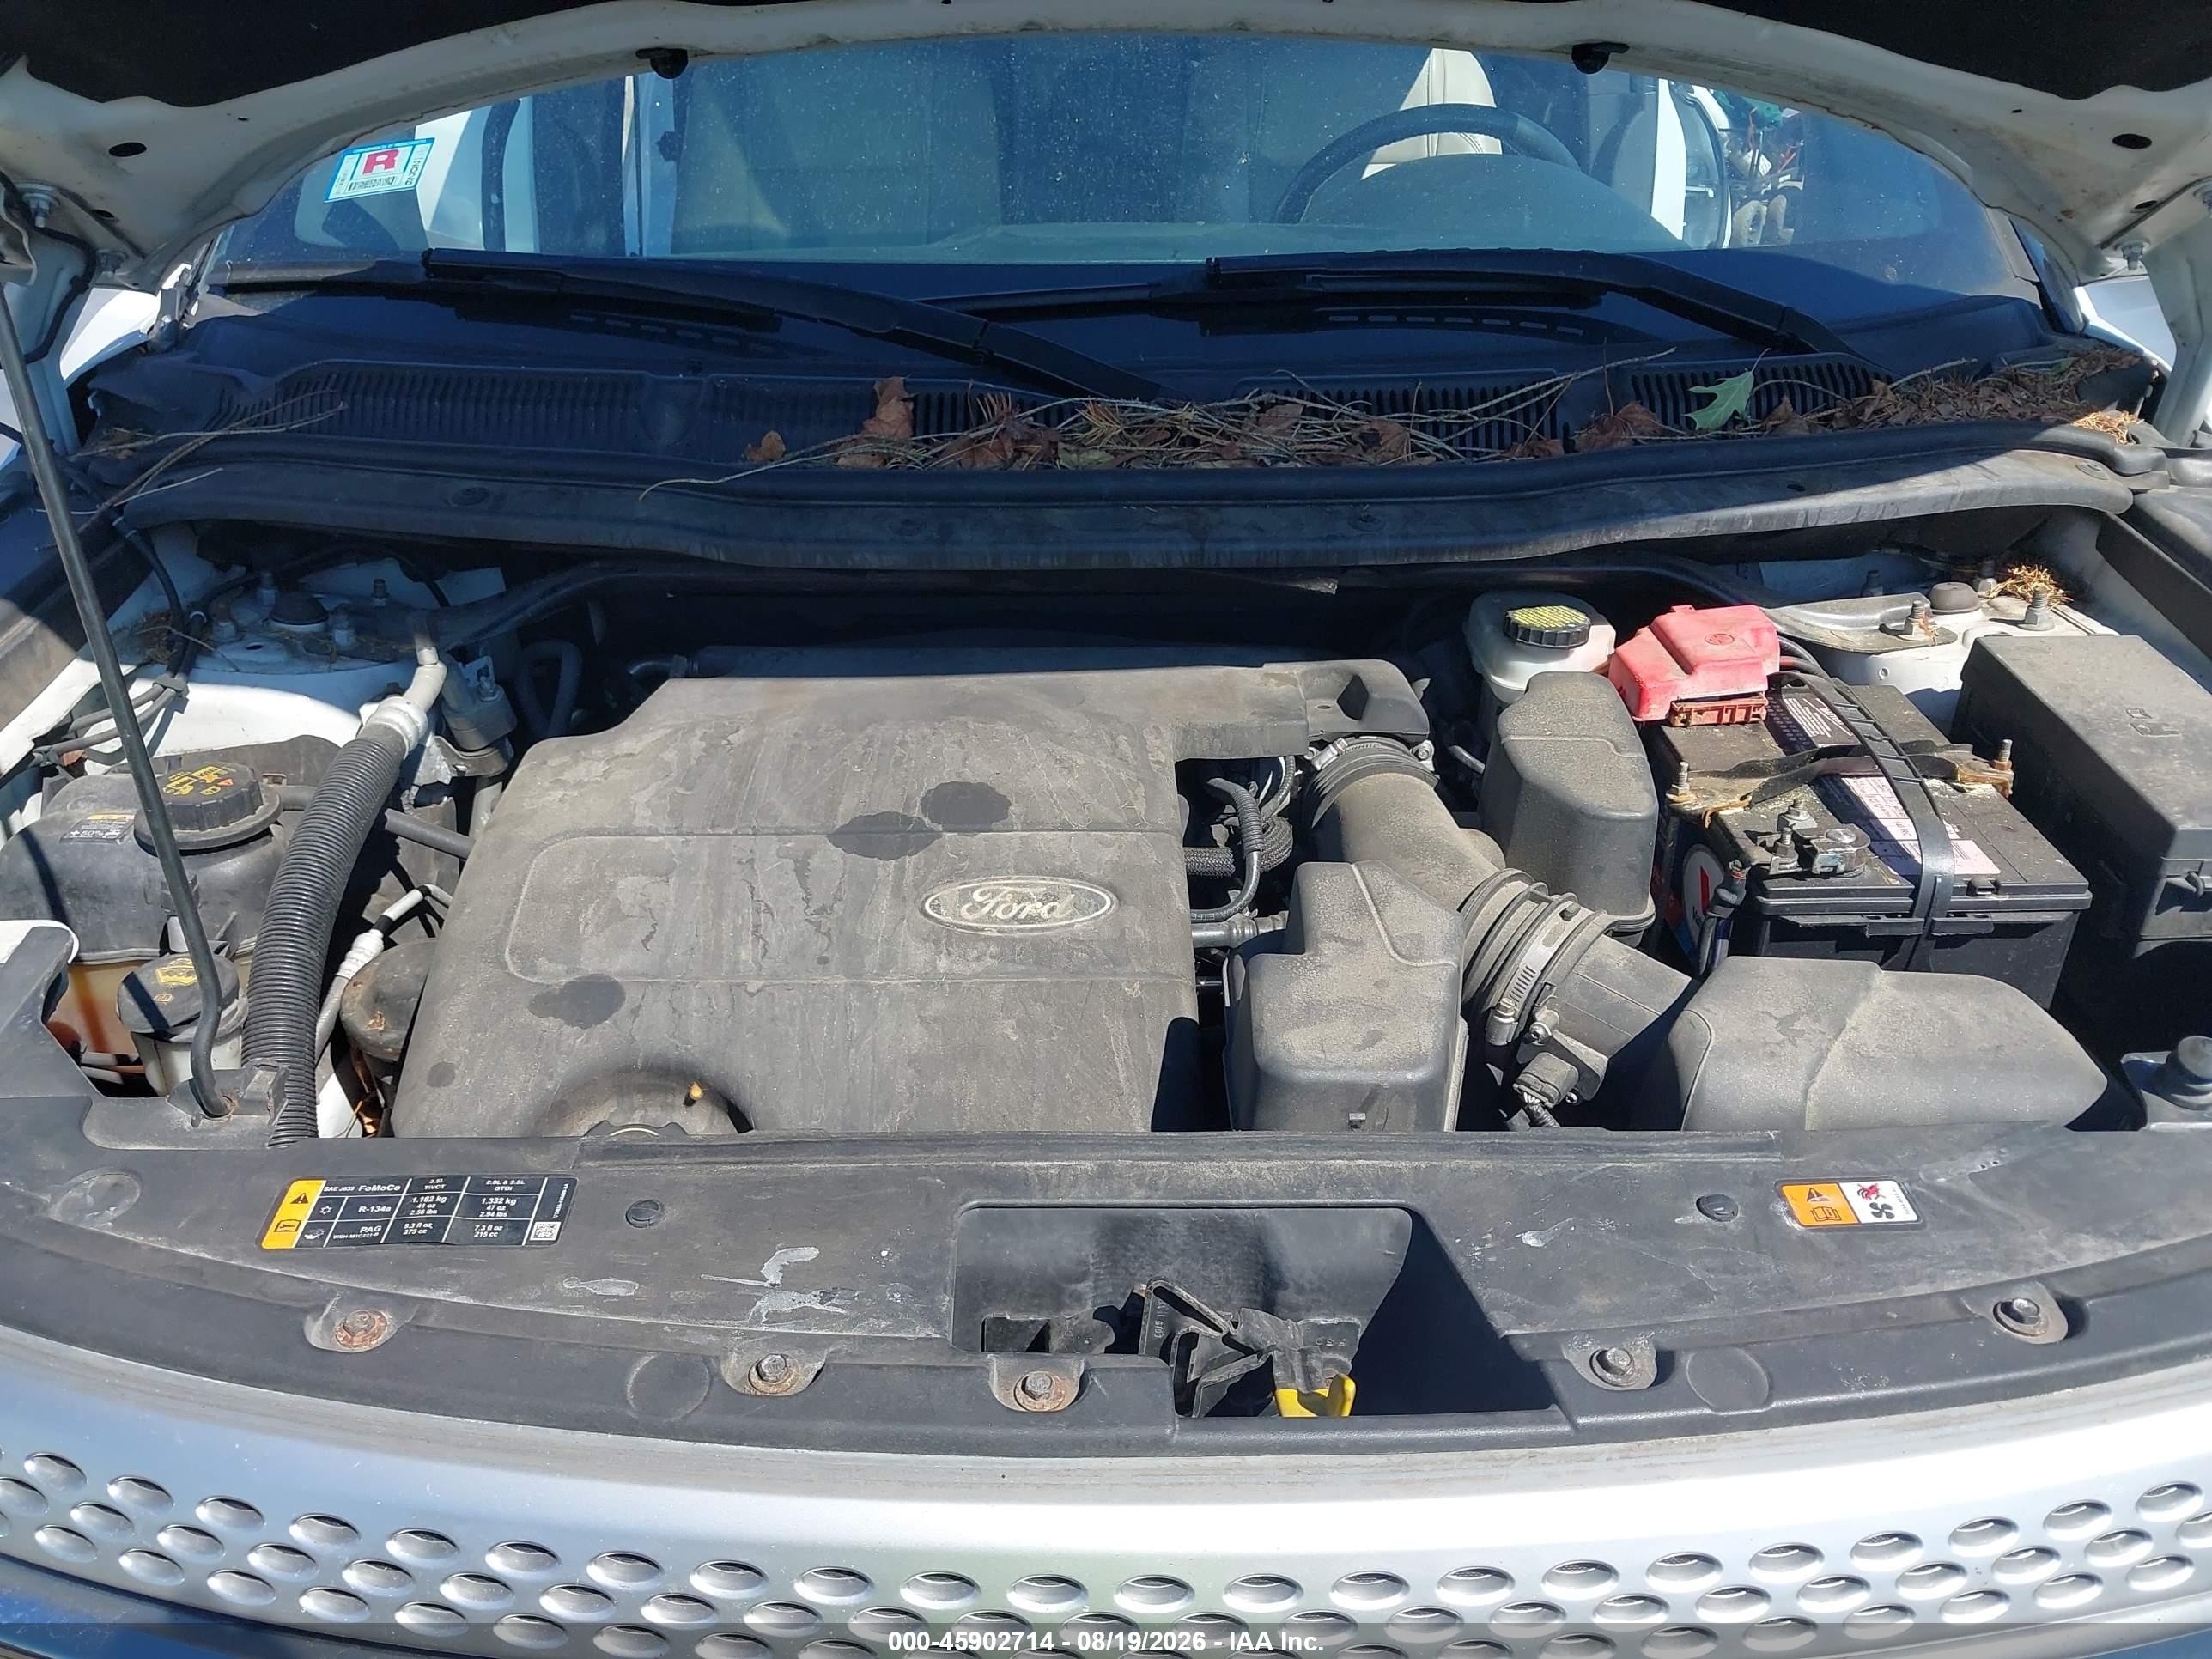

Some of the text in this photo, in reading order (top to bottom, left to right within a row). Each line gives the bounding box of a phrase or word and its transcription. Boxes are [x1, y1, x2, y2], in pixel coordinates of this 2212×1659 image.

[363, 149, 399, 174] R
[961, 884, 1076, 920] Ford
[435, 1195, 447, 1203] kg
[505, 1197, 517, 1206] kg
